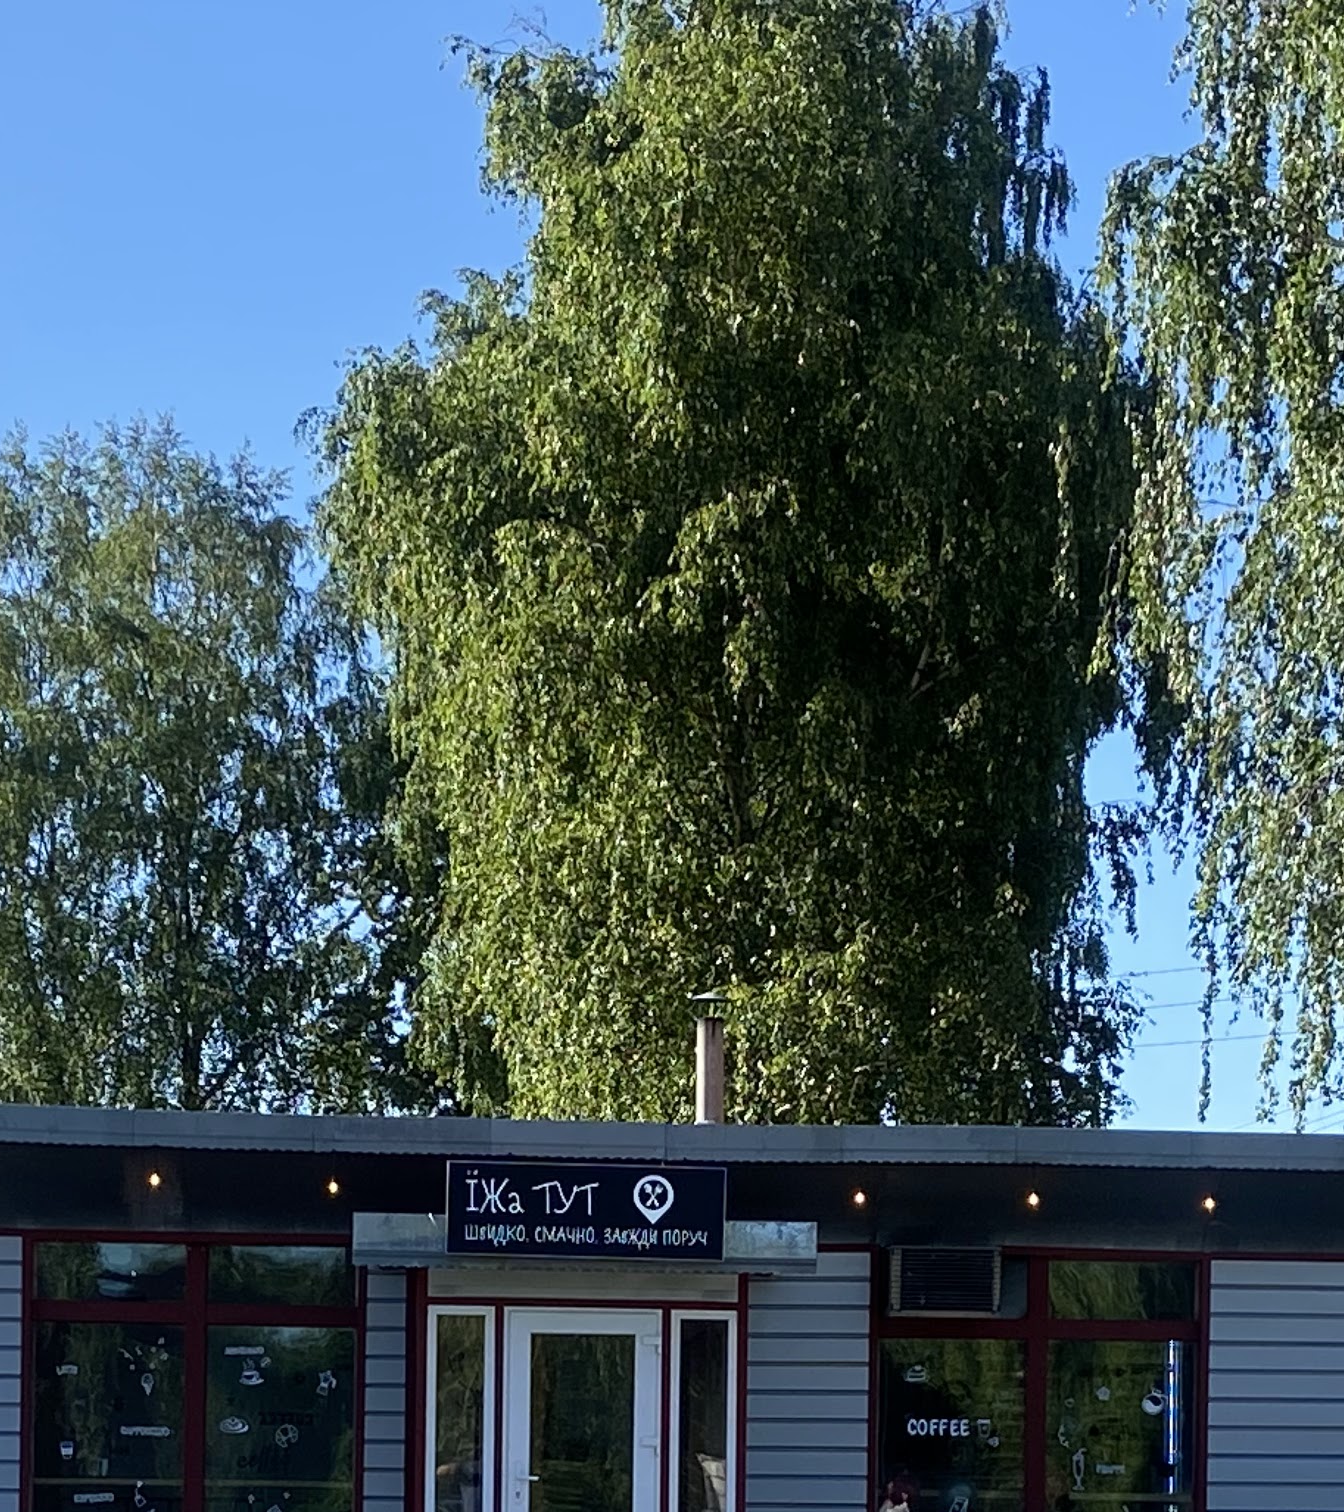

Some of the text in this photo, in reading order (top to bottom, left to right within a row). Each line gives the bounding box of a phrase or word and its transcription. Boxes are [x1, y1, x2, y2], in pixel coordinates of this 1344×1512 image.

[531, 1180, 600, 1216] ТУТ
[662, 1228, 708, 1247] ПОРУЧ
[907, 1419, 970, 1436] COFFEE
